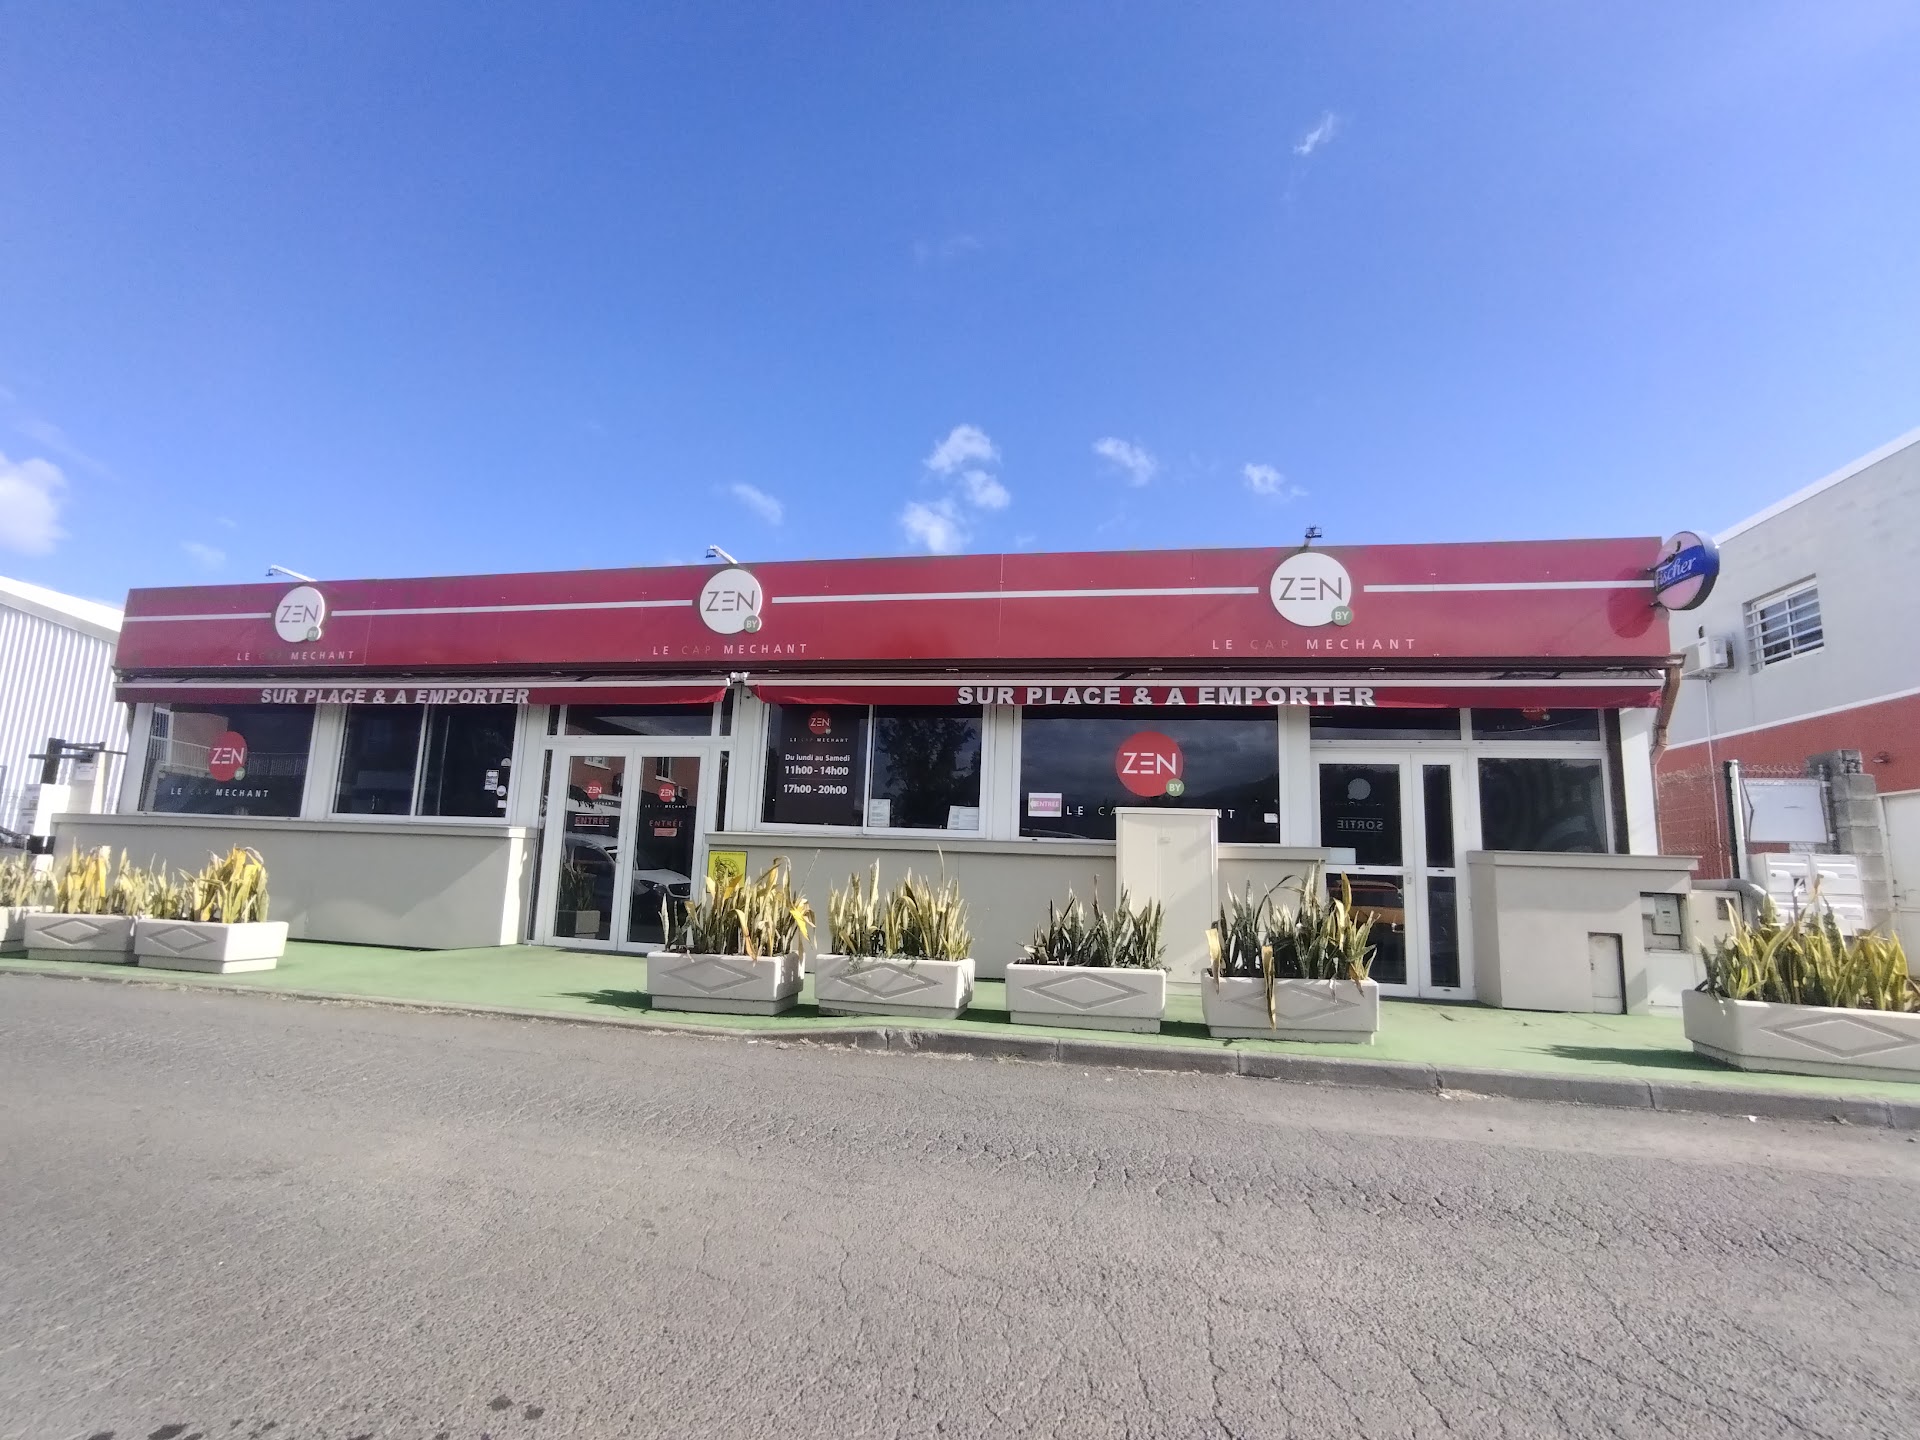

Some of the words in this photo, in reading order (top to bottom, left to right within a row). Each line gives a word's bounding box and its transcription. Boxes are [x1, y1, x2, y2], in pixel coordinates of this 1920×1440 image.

[1279, 577, 1342, 601] ZEN
[706, 590, 755, 611] ZEN
[280, 605, 319, 623] ZEN
[1334, 611, 1349, 621] BY
[746, 620, 758, 629] BY
[653, 646, 669, 655] LE
[682, 646, 711, 655] CAP
[723, 644, 807, 654] MECHANT
[1212, 640, 1233, 650] LE
[1250, 640, 1289, 650] CAP
[1306, 638, 1415, 650] MECHANT
[237, 652, 250, 661] LE
[291, 651, 354, 660] MECHANT
[261, 688, 298, 703] SUR
[304, 688, 366, 704] PLACE
[372, 688, 386, 704] &
[392, 689, 407, 704] A
[415, 688, 530, 705] EMPORTER
[957, 687, 1015, 705] SUR
[1026, 687, 1121, 705] PLACE
[1132, 687, 1153, 705] &
[1164, 687, 1187, 705] A
[1198, 687, 1376, 706] EMPORTER
[810, 718, 830, 727] ZEN
[211, 747, 244, 764] ZEN
[825, 754, 850, 762] Samedi
[1122, 752, 1177, 775] ZEN
[784, 765, 813, 775] 11h00
[820, 766, 849, 776] 14h00
[171, 787, 182, 795] LE
[216, 788, 269, 797] MECHANT
[660, 788, 675, 797] ZEN
[783, 784, 811, 794] 17h00
[818, 785, 848, 795] 20h00
[1169, 783, 1181, 792] BY
[1066, 806, 1084, 815] LE
[1098, 807, 1116, 816] CA
